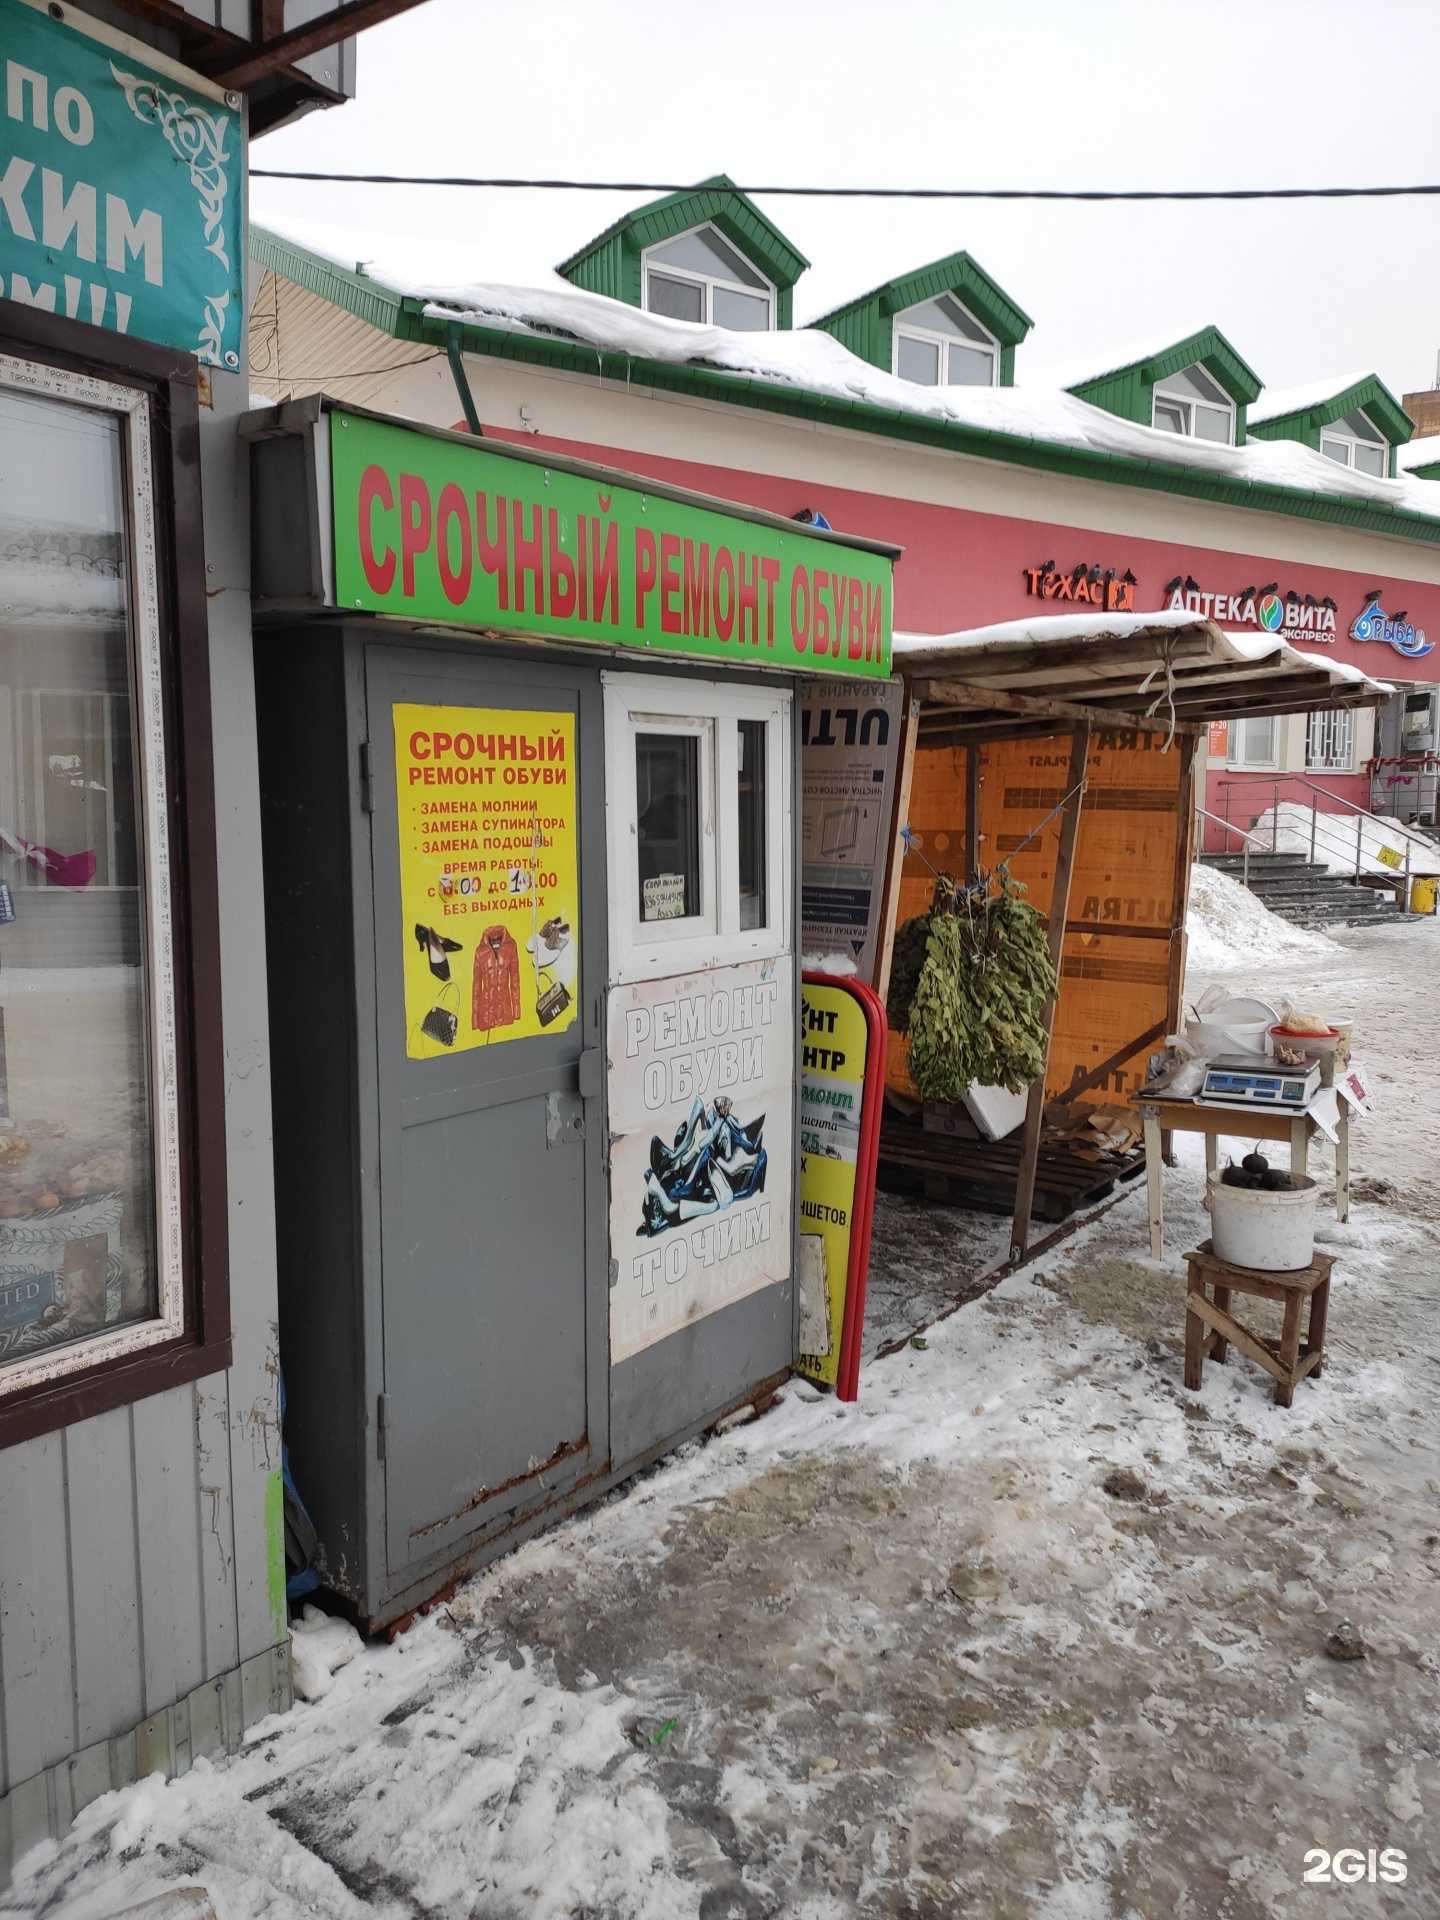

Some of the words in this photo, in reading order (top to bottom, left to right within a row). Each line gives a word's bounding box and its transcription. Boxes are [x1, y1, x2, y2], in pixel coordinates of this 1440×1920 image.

[358, 464, 620, 626] СРОЧНЫЙ
[635, 526, 781, 648] РЕМОНТ
[789, 564, 882, 665] ОБУВИ
[1168, 588, 1258, 624] АПТЕКА
[1285, 602, 1337, 632] ВИТА
[1281, 628, 1336, 644] ЭКСПРЕСС
[409, 729, 565, 762] СРОЧНЫЙ
[408, 766, 496, 786] РЕМОНТ
[503, 767, 567, 785] ОБУВИ
[420, 800, 477, 815] ЗАМЕНА
[482, 800, 538, 813] МОЛНИИ
[422, 820, 478, 834] ЗАМЕНА
[482, 818, 566, 831] СУПИНАТОРА
[422, 841, 479, 854] ЗАМЕНА
[443, 861, 487, 874] ВРЕМЯ
[488, 881, 507, 894] до
[443, 903, 468, 916] БЕЗ
[625, 981, 778, 1058] РЕМОНТ
[643, 1035, 764, 1111] ОБУВИ
[632, 1202, 772, 1298] ТОЧИМ
